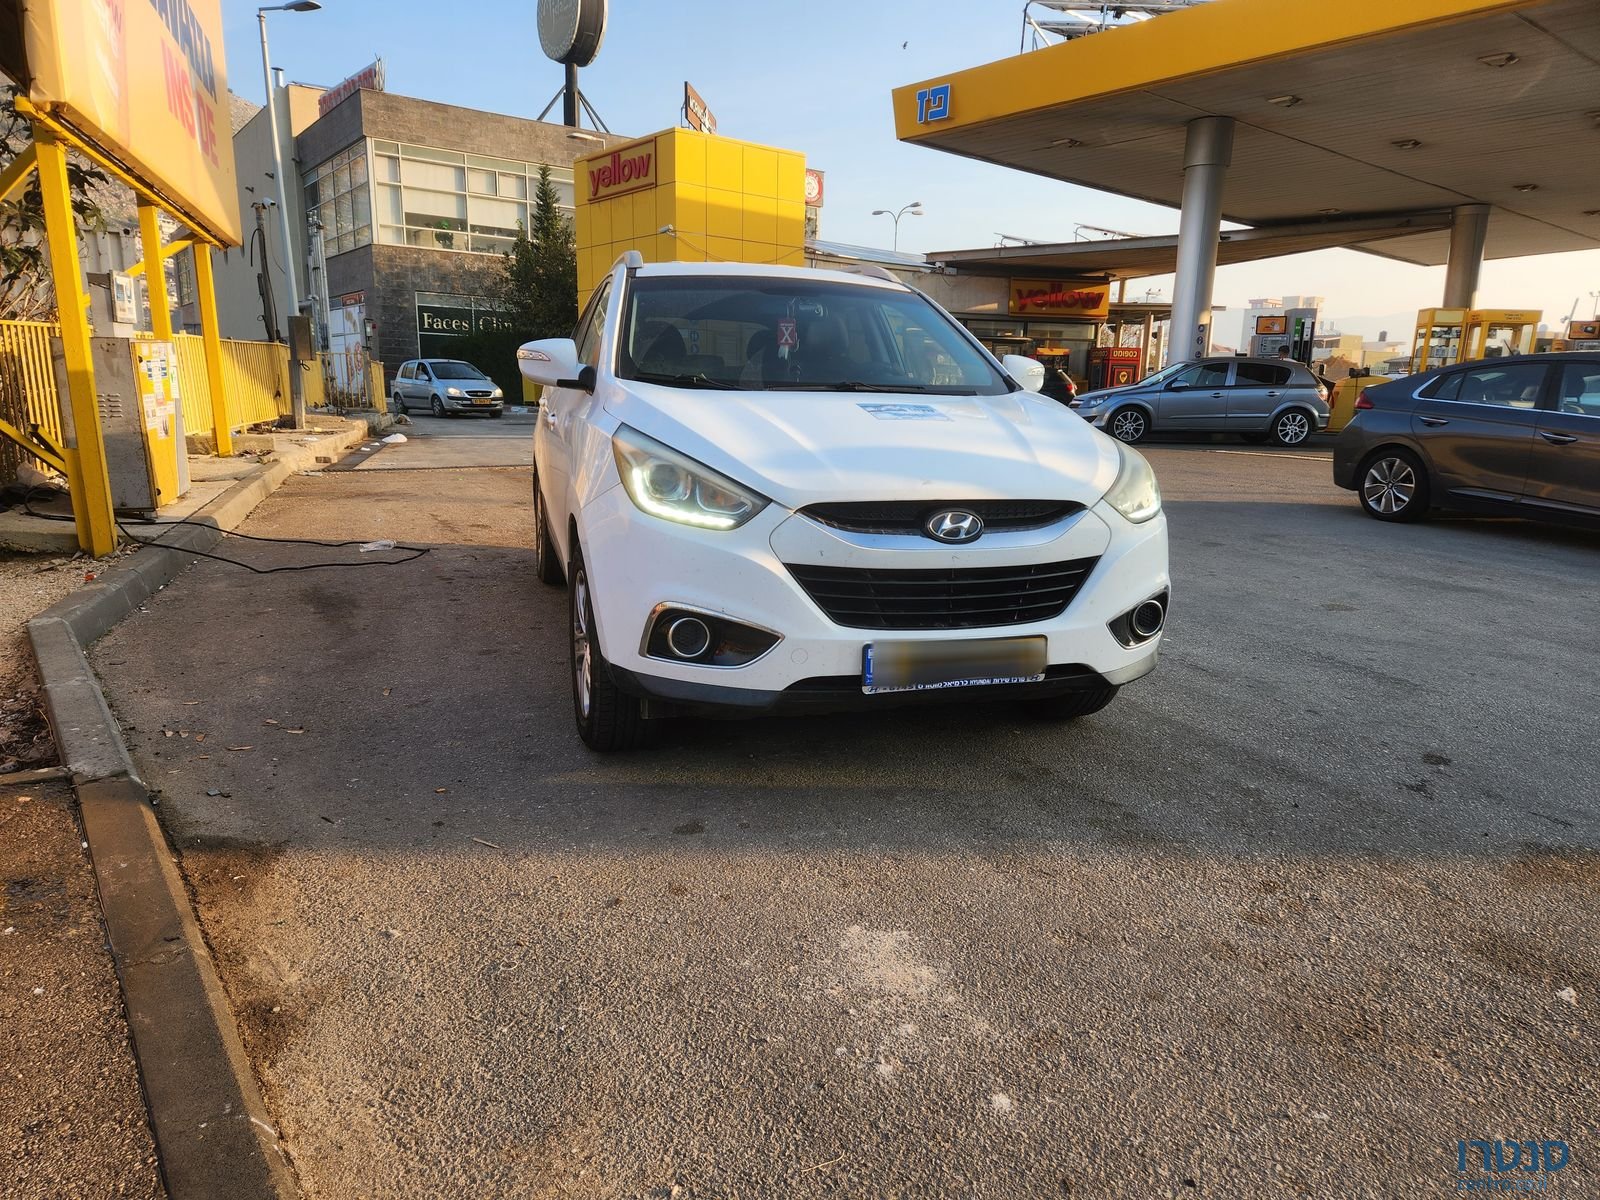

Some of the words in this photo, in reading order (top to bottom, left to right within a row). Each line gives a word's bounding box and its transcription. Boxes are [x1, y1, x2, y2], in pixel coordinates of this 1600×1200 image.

[160, 34, 220, 169] INSDE
[916, 83, 951, 123] פז
[588, 151, 652, 197] yellow
[1015, 282, 1105, 312] yellow
[422, 312, 470, 331] Faces
